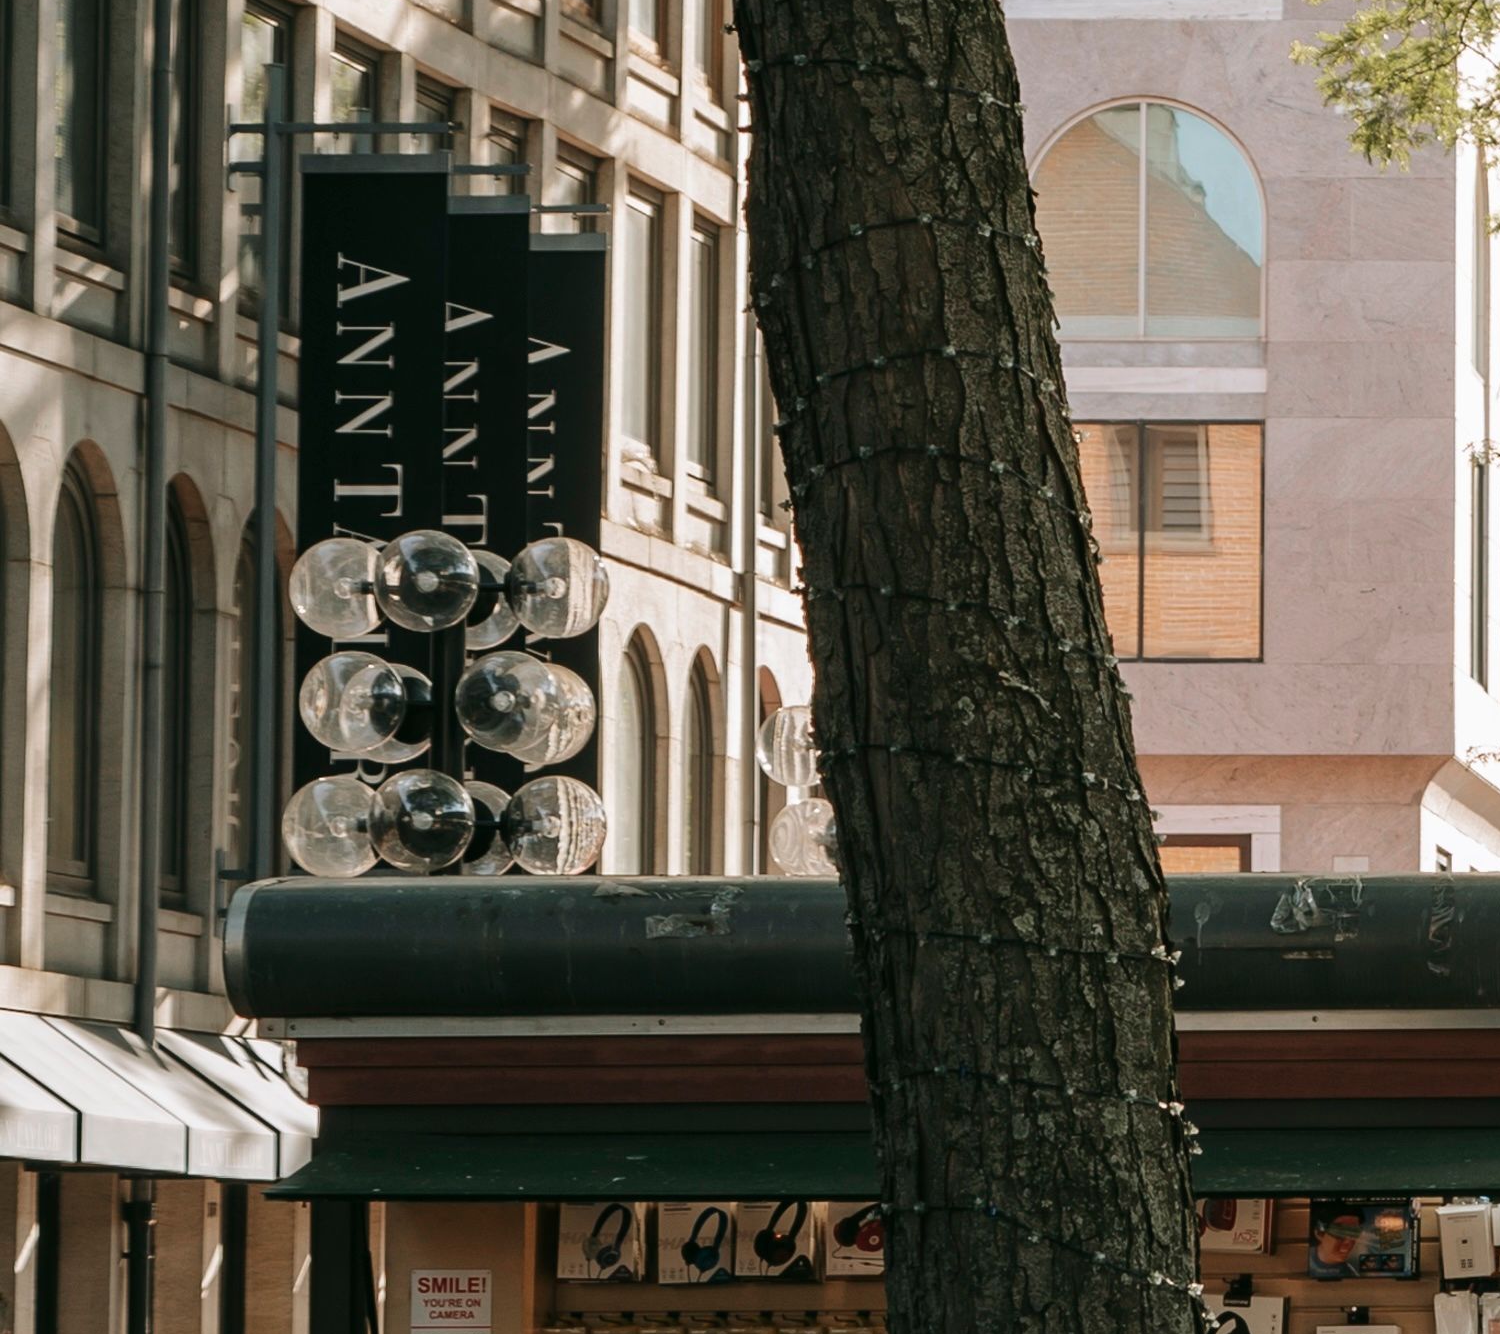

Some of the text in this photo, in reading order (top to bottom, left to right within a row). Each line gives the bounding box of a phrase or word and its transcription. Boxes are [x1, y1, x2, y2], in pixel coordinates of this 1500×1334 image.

[418, 1277, 486, 1294] SMILE!
[423, 1298, 481, 1308] YOU'RE ON
[429, 1310, 475, 1320] CAMERA
